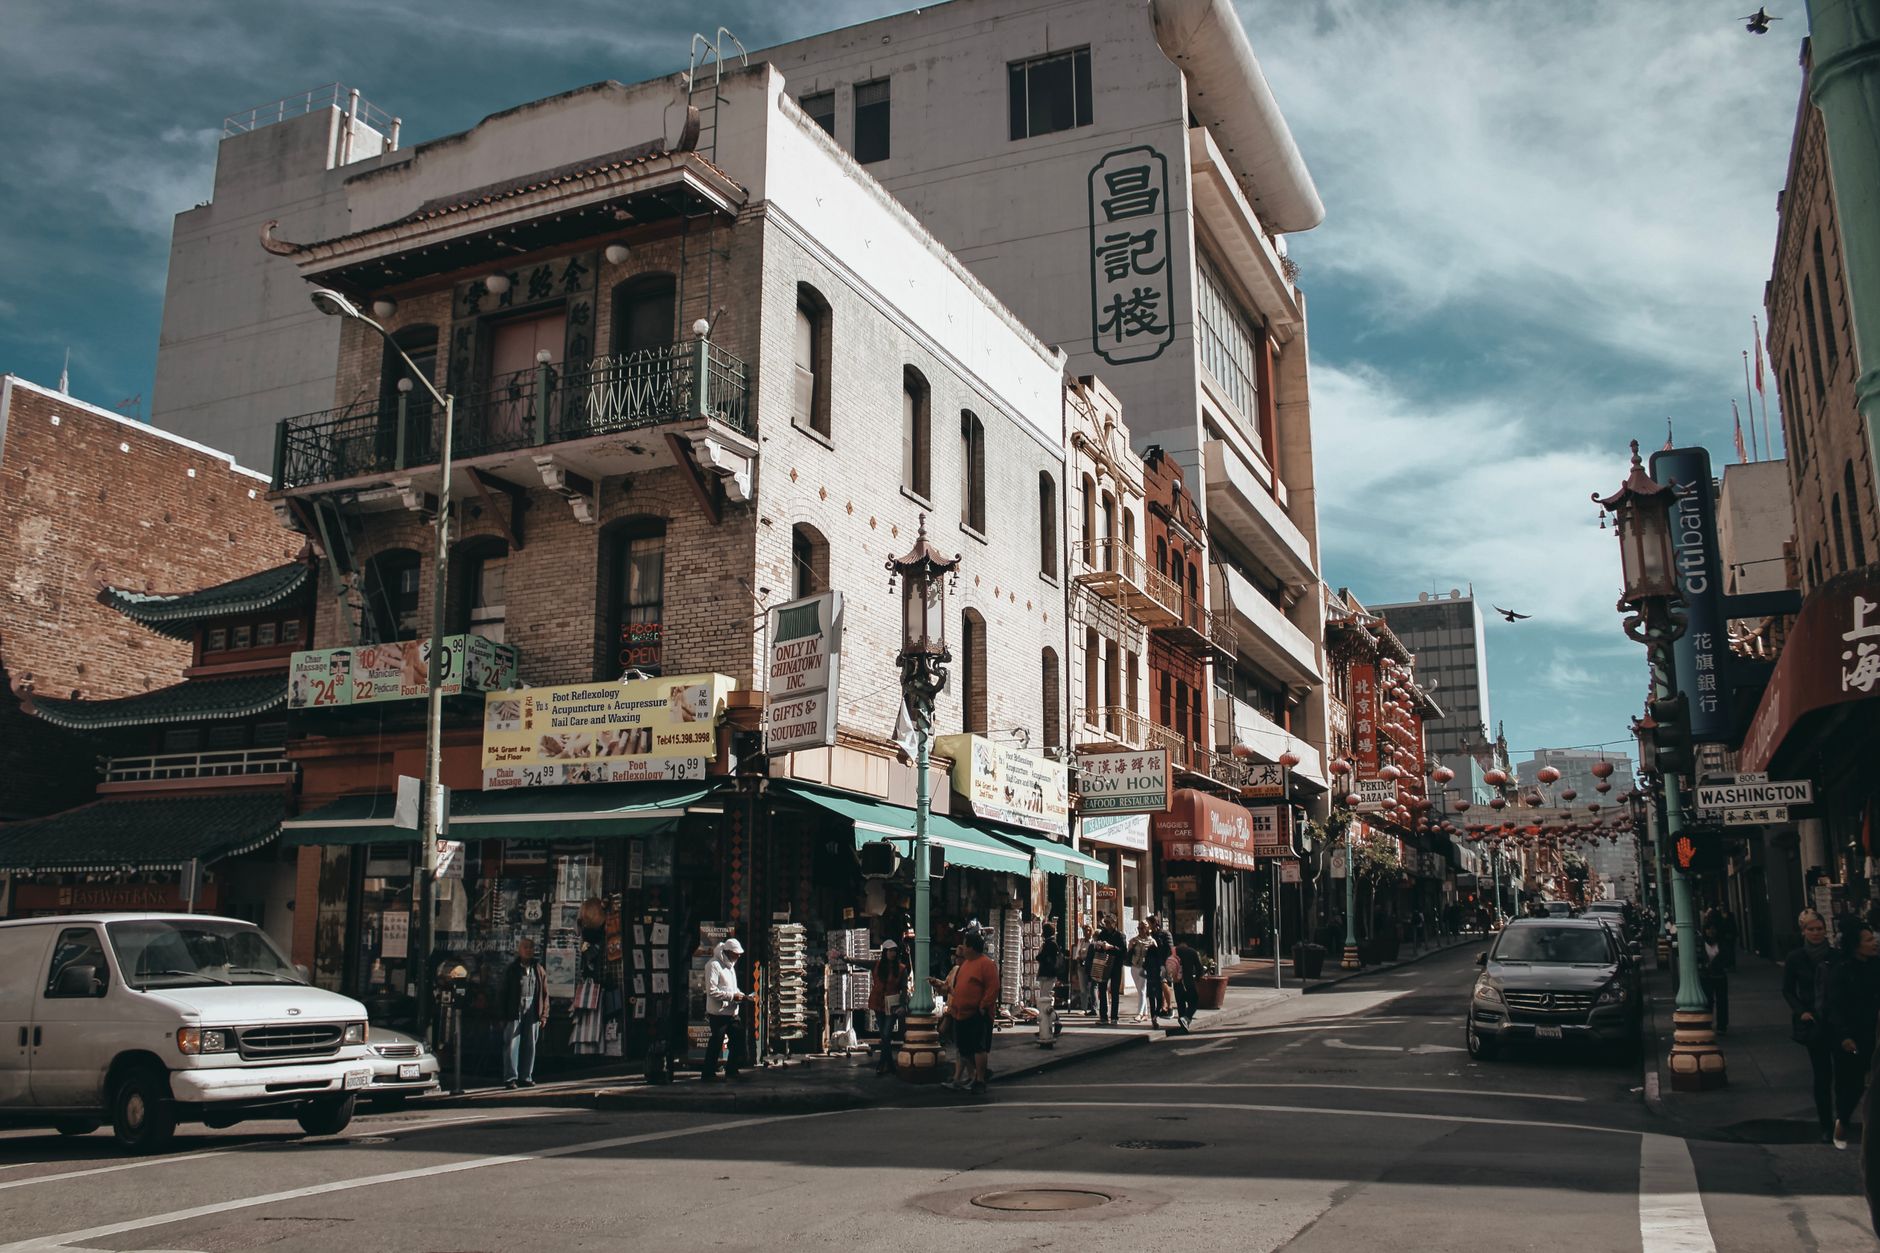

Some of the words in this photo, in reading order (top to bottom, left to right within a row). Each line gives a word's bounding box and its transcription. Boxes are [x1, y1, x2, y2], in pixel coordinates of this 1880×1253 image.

[1679, 480, 1707, 594] citibank
[474, 638, 488, 650] Chair
[776, 641, 805, 662] ONLY
[804, 638, 818, 656] IN
[468, 646, 492, 660] Massage
[618, 646, 660, 665] OPEN
[305, 655, 322, 664] Chair
[296, 663, 328, 673] Massage
[771, 654, 822, 678] CHINATOWN
[368, 668, 399, 679] Manicure
[1692, 632, 1718, 713] 花旗銀行
[786, 674, 806, 690] INC.
[373, 683, 399, 694] Pedicure
[401, 685, 418, 696] Foot
[552, 692, 569, 702] Foot
[571, 687, 620, 702] Reflexology
[552, 703, 605, 715] Acupuncture
[614, 698, 667, 711] Acupressure
[773, 702, 803, 722] GIFTS
[805, 699, 816, 715] &
[551, 717, 568, 728] Nail
[570, 715, 588, 726] Care
[590, 714, 606, 725] and
[608, 712, 640, 727] Waxing
[1355, 679, 1374, 753] 北京商場
[771, 721, 817, 741] SOUVENIR
[501, 746, 518, 754] Grant
[628, 760, 647, 771] Foot
[496, 768, 514, 779] Chair
[612, 770, 664, 781] Reflexology
[1739, 774, 1756, 783] 800
[489, 776, 522, 788] Massage
[1082, 778, 1119, 792] BOW
[1127, 775, 1163, 790] HON
[1360, 781, 1392, 791] PEKING
[1700, 785, 1807, 805] WASHINGTON
[1119, 796, 1165, 807] RESTAURANT
[1157, 821, 1189, 829] MAGGIE'S
[1263, 846, 1288, 854] CENTER
[528, 910, 539, 918] 66
